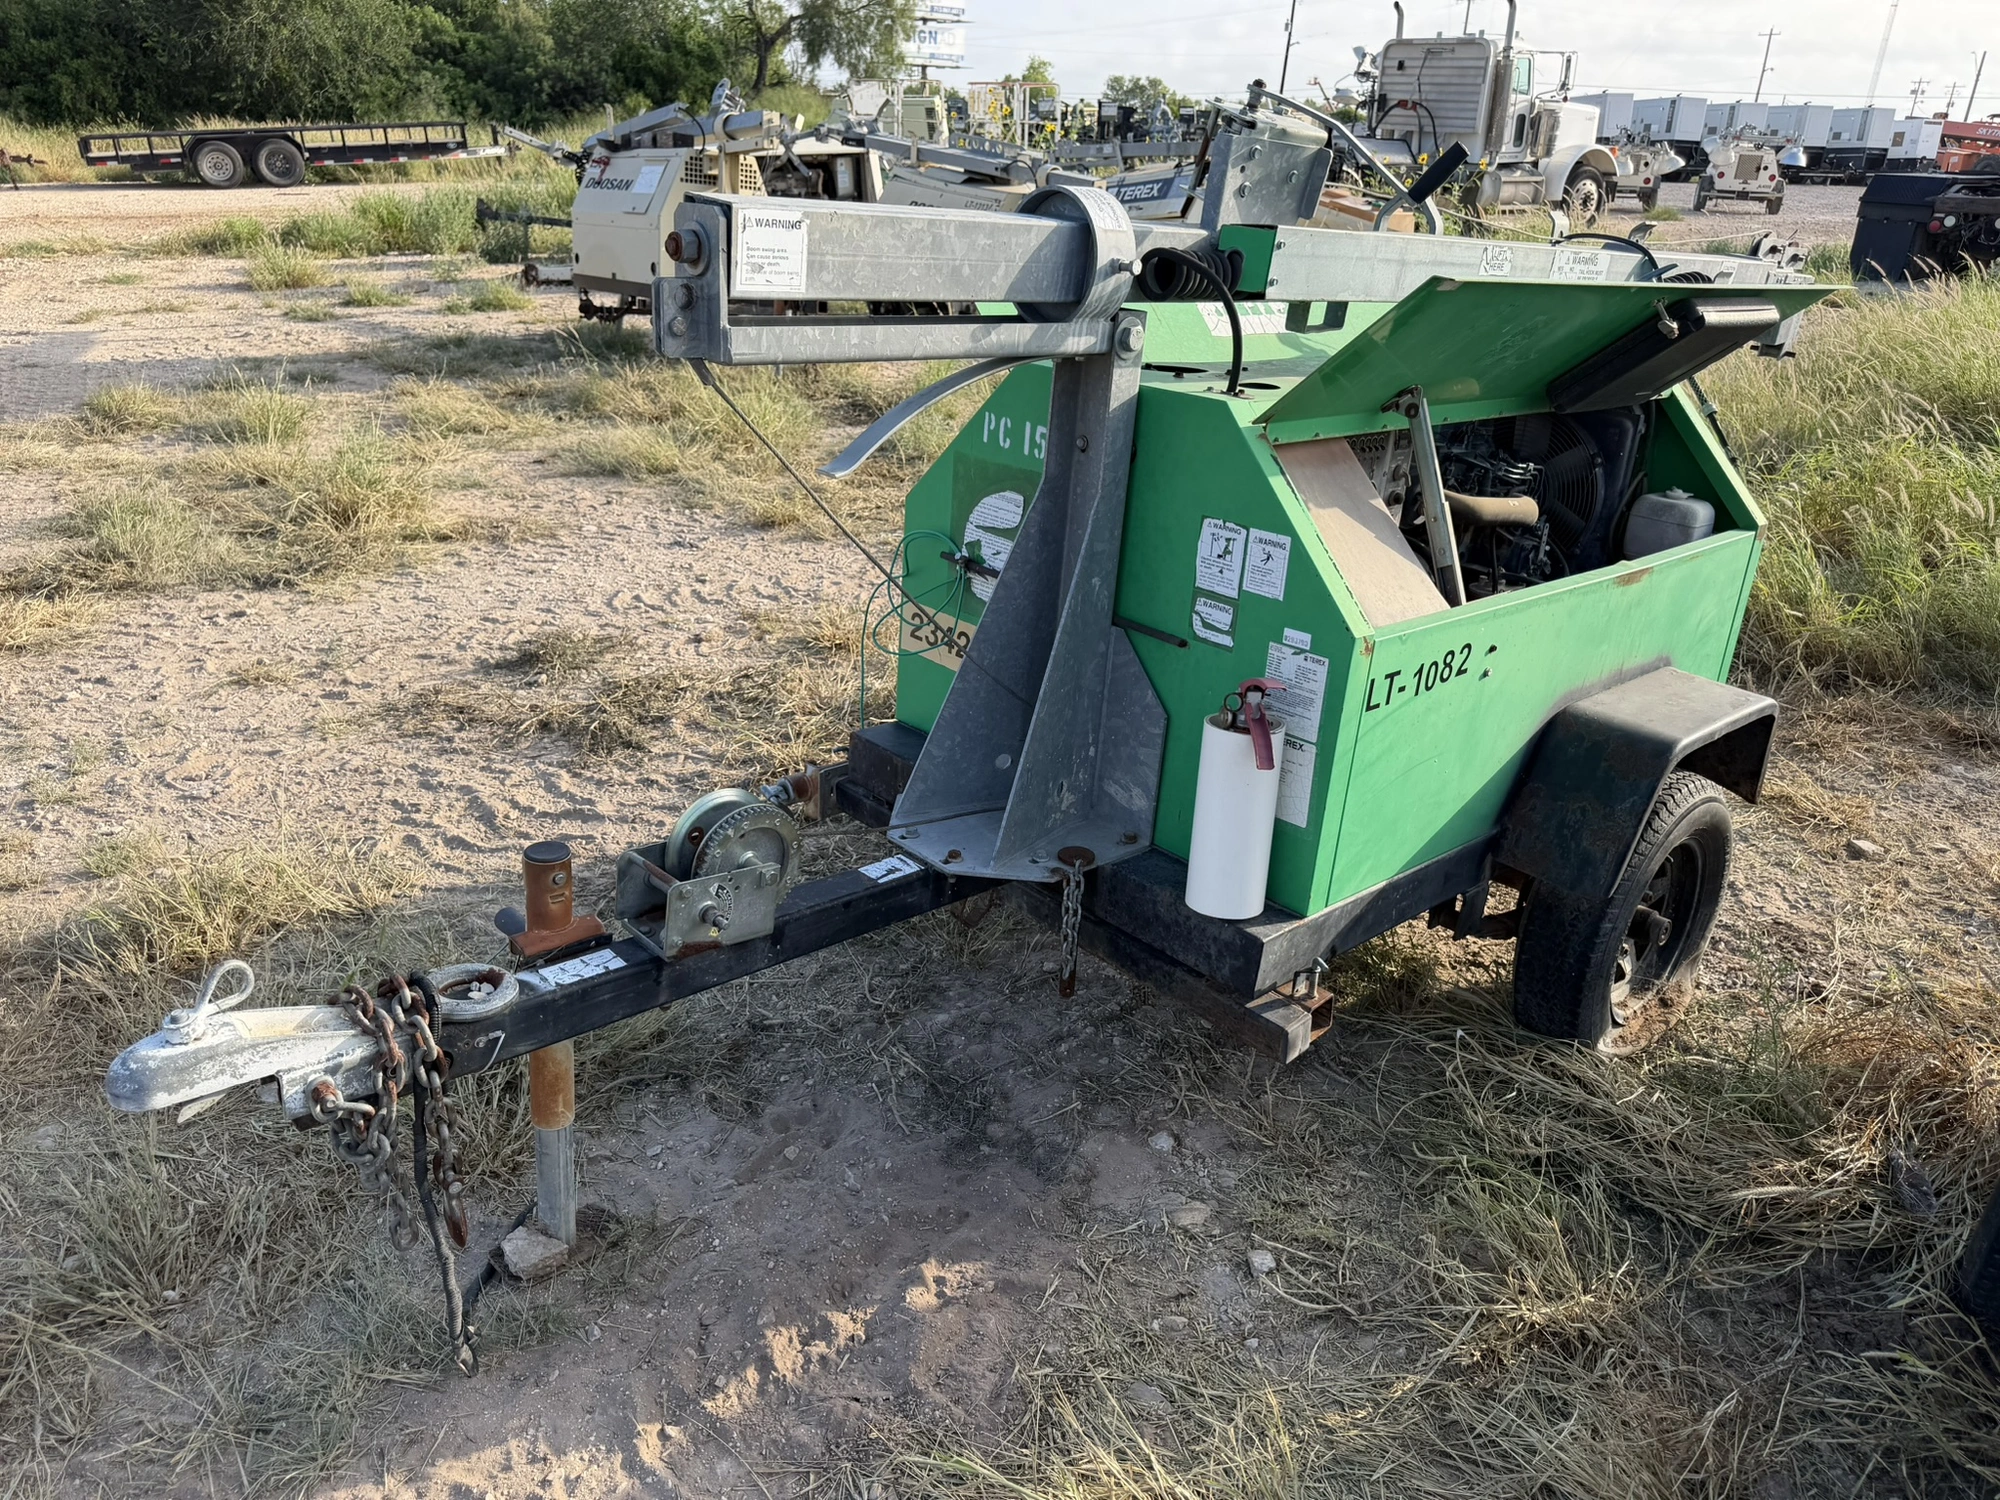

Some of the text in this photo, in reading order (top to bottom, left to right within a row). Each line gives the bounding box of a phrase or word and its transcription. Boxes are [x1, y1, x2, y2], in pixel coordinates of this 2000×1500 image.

[585, 177, 633, 191] DOOSAN
[1119, 182, 1162, 200] TEREX
[755, 218, 802, 230] WARNING
[1571, 255, 1599, 267] WARNING
[983, 411, 1011, 449] PC
[1213, 523, 1242, 536] WARNING
[1258, 537, 1287, 551] WARNING
[1202, 600, 1232, 615] WARNING
[909, 612, 971, 659] 2342
[1365, 643, 1473, 712] LT-1082
